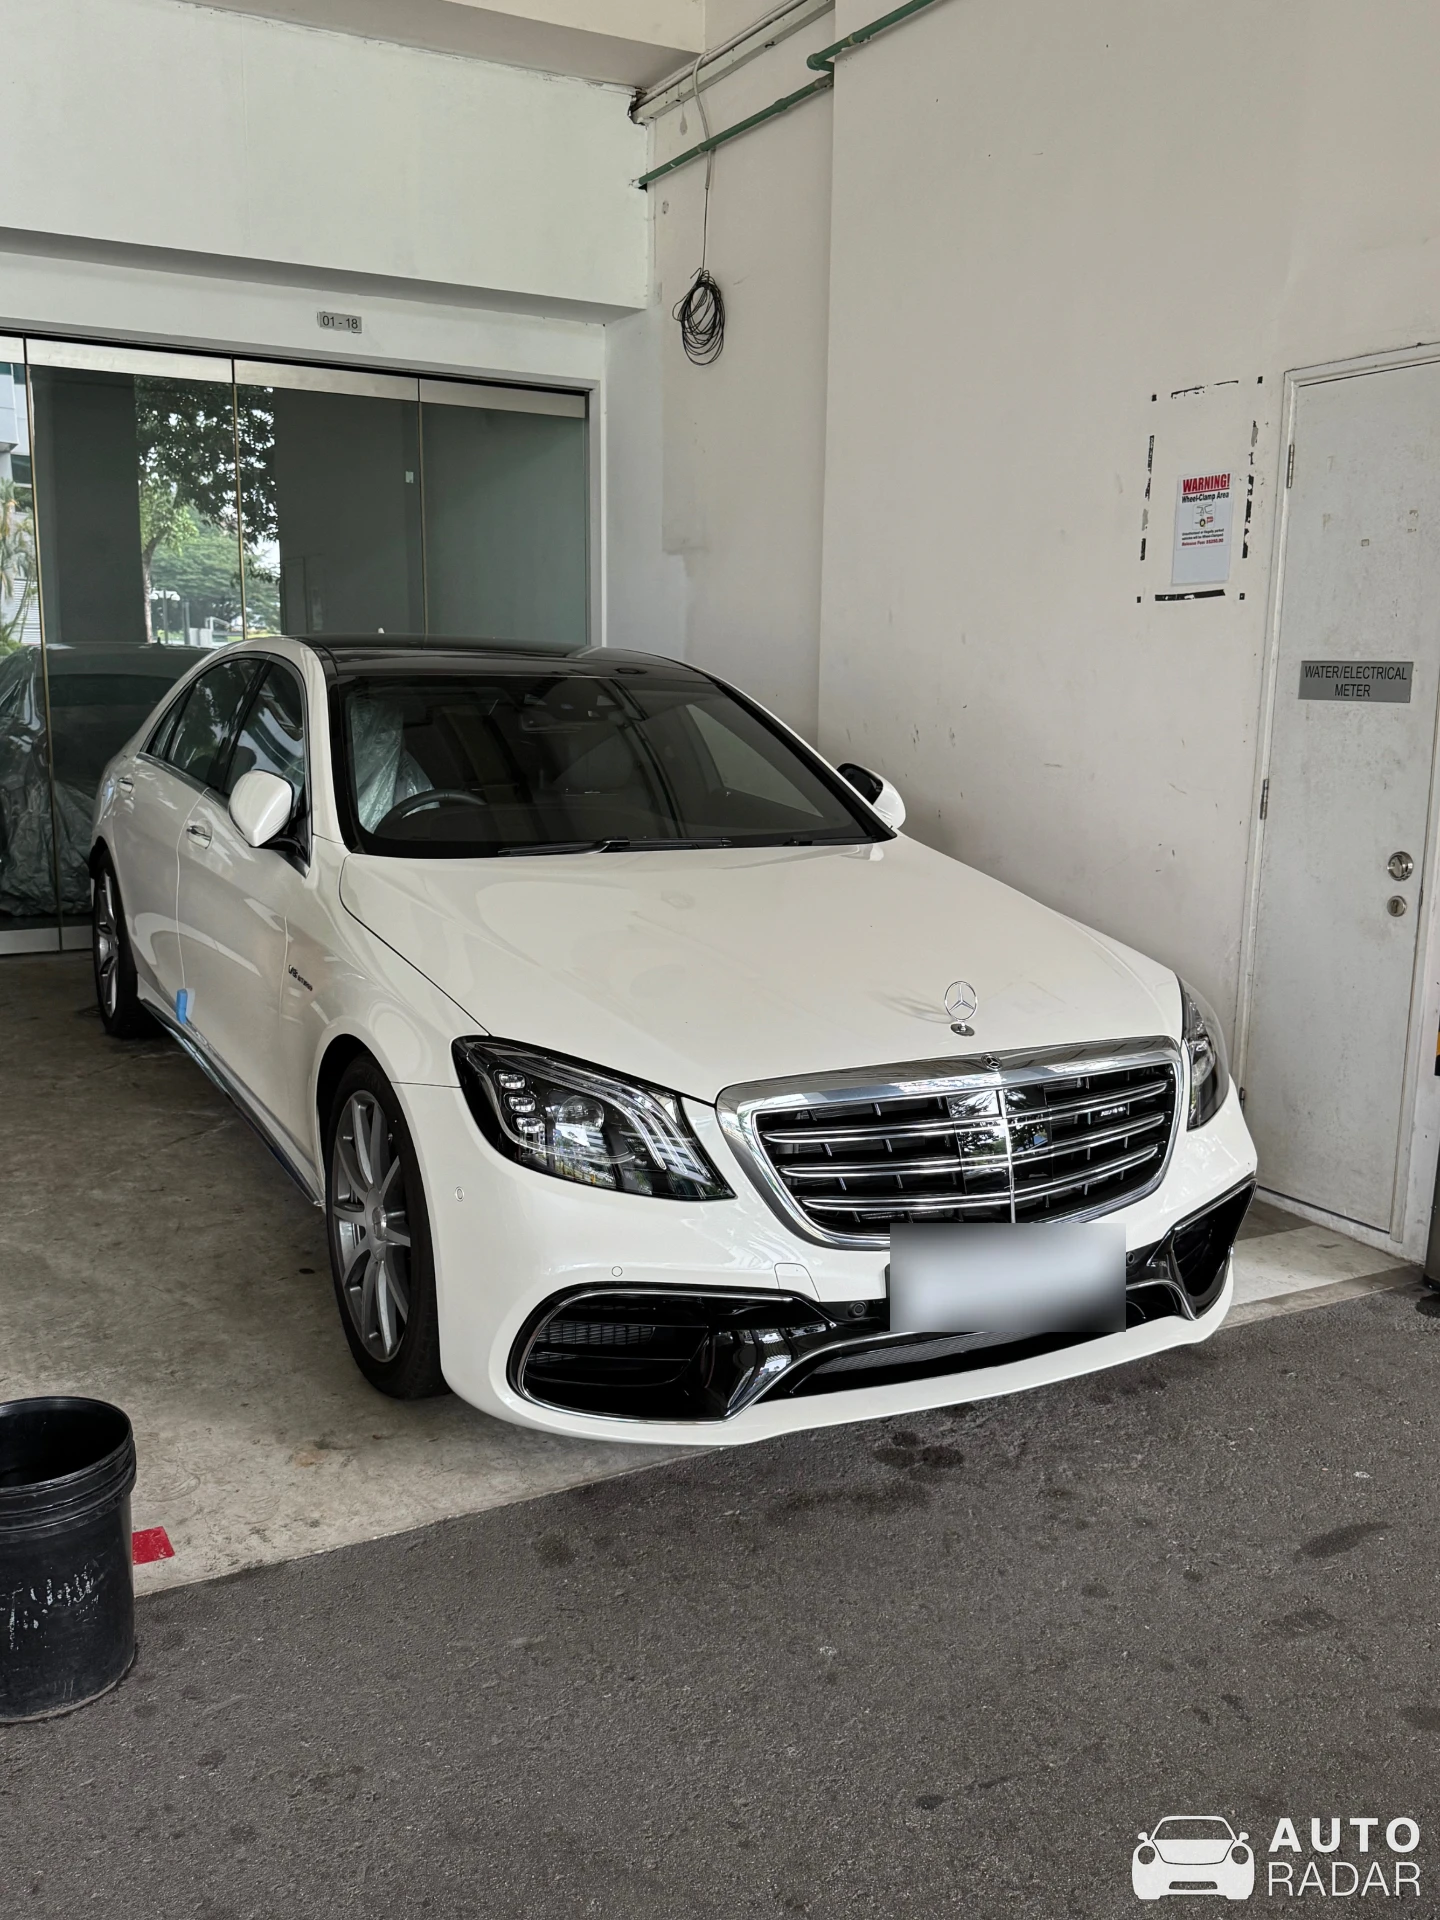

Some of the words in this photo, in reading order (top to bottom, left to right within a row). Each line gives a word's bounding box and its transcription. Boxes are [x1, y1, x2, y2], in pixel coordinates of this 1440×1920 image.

[322, 315, 335, 327] 01
[346, 318, 358, 330] 18
[1183, 473, 1231, 493] WARNING!
[1182, 493, 1215, 504] Wheel-Clamp
[1216, 491, 1230, 500] Area
[1304, 665, 1408, 681] WATER/ELECTRICAL
[1334, 683, 1371, 697] METER
